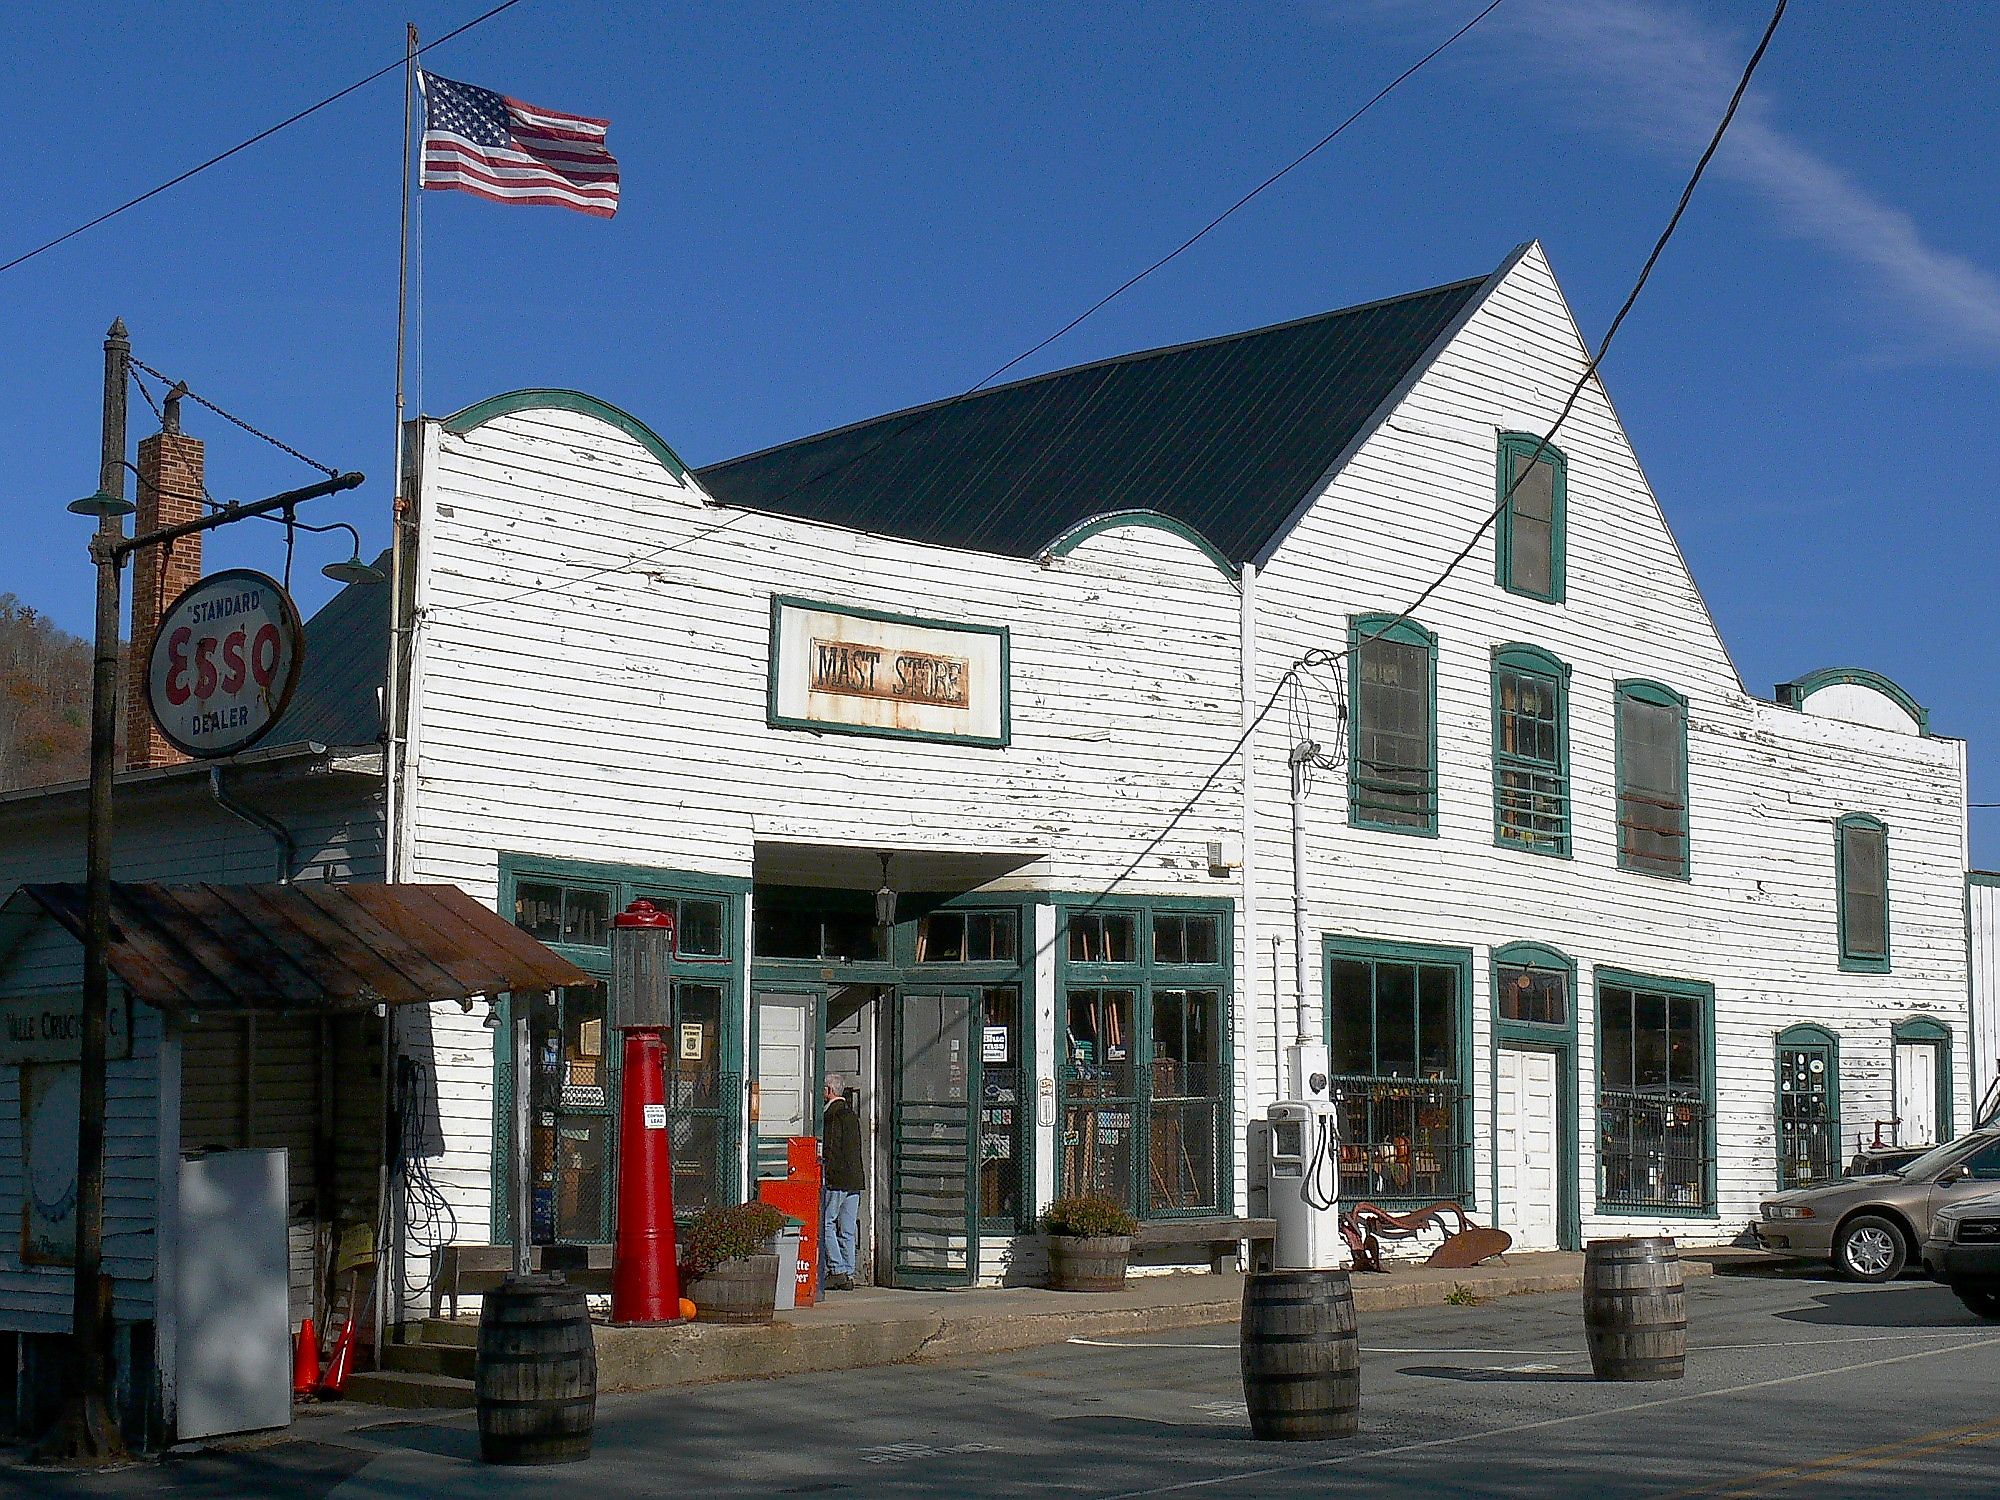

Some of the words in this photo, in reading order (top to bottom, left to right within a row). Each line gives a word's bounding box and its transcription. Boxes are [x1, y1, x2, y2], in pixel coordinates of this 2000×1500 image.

[165, 623, 281, 706] ESSO
[817, 645, 880, 691] MAST
[892, 655, 963, 702] STORE
[192, 705, 249, 736] DEALER
